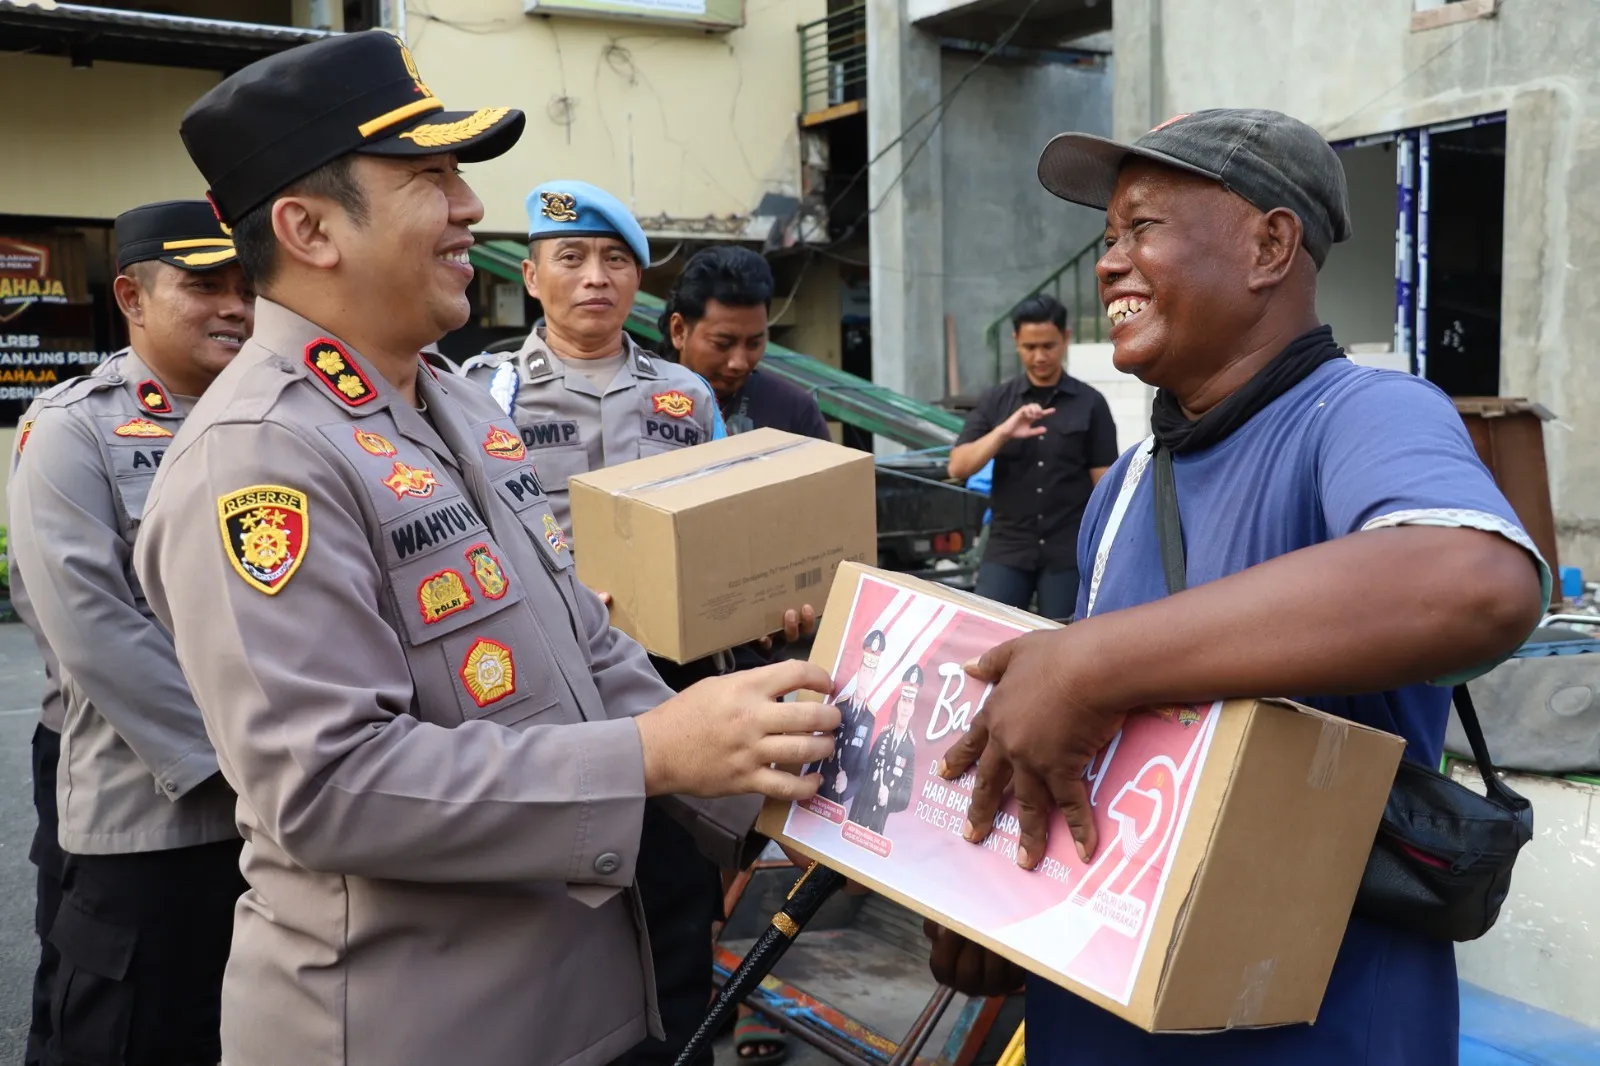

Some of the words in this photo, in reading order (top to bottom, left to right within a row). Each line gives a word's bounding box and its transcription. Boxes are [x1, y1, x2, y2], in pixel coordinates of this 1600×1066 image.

[0, 351, 65, 365] ANJUNG
[0, 369, 57, 382] AHAJA
[646, 419, 699, 446] POLRI
[226, 491, 299, 512] RESERSE
[434, 598, 462, 616] POLRI
[921, 779, 949, 805] HARI
[914, 801, 948, 829] POLRES
[1040, 856, 1072, 884] PERAK
